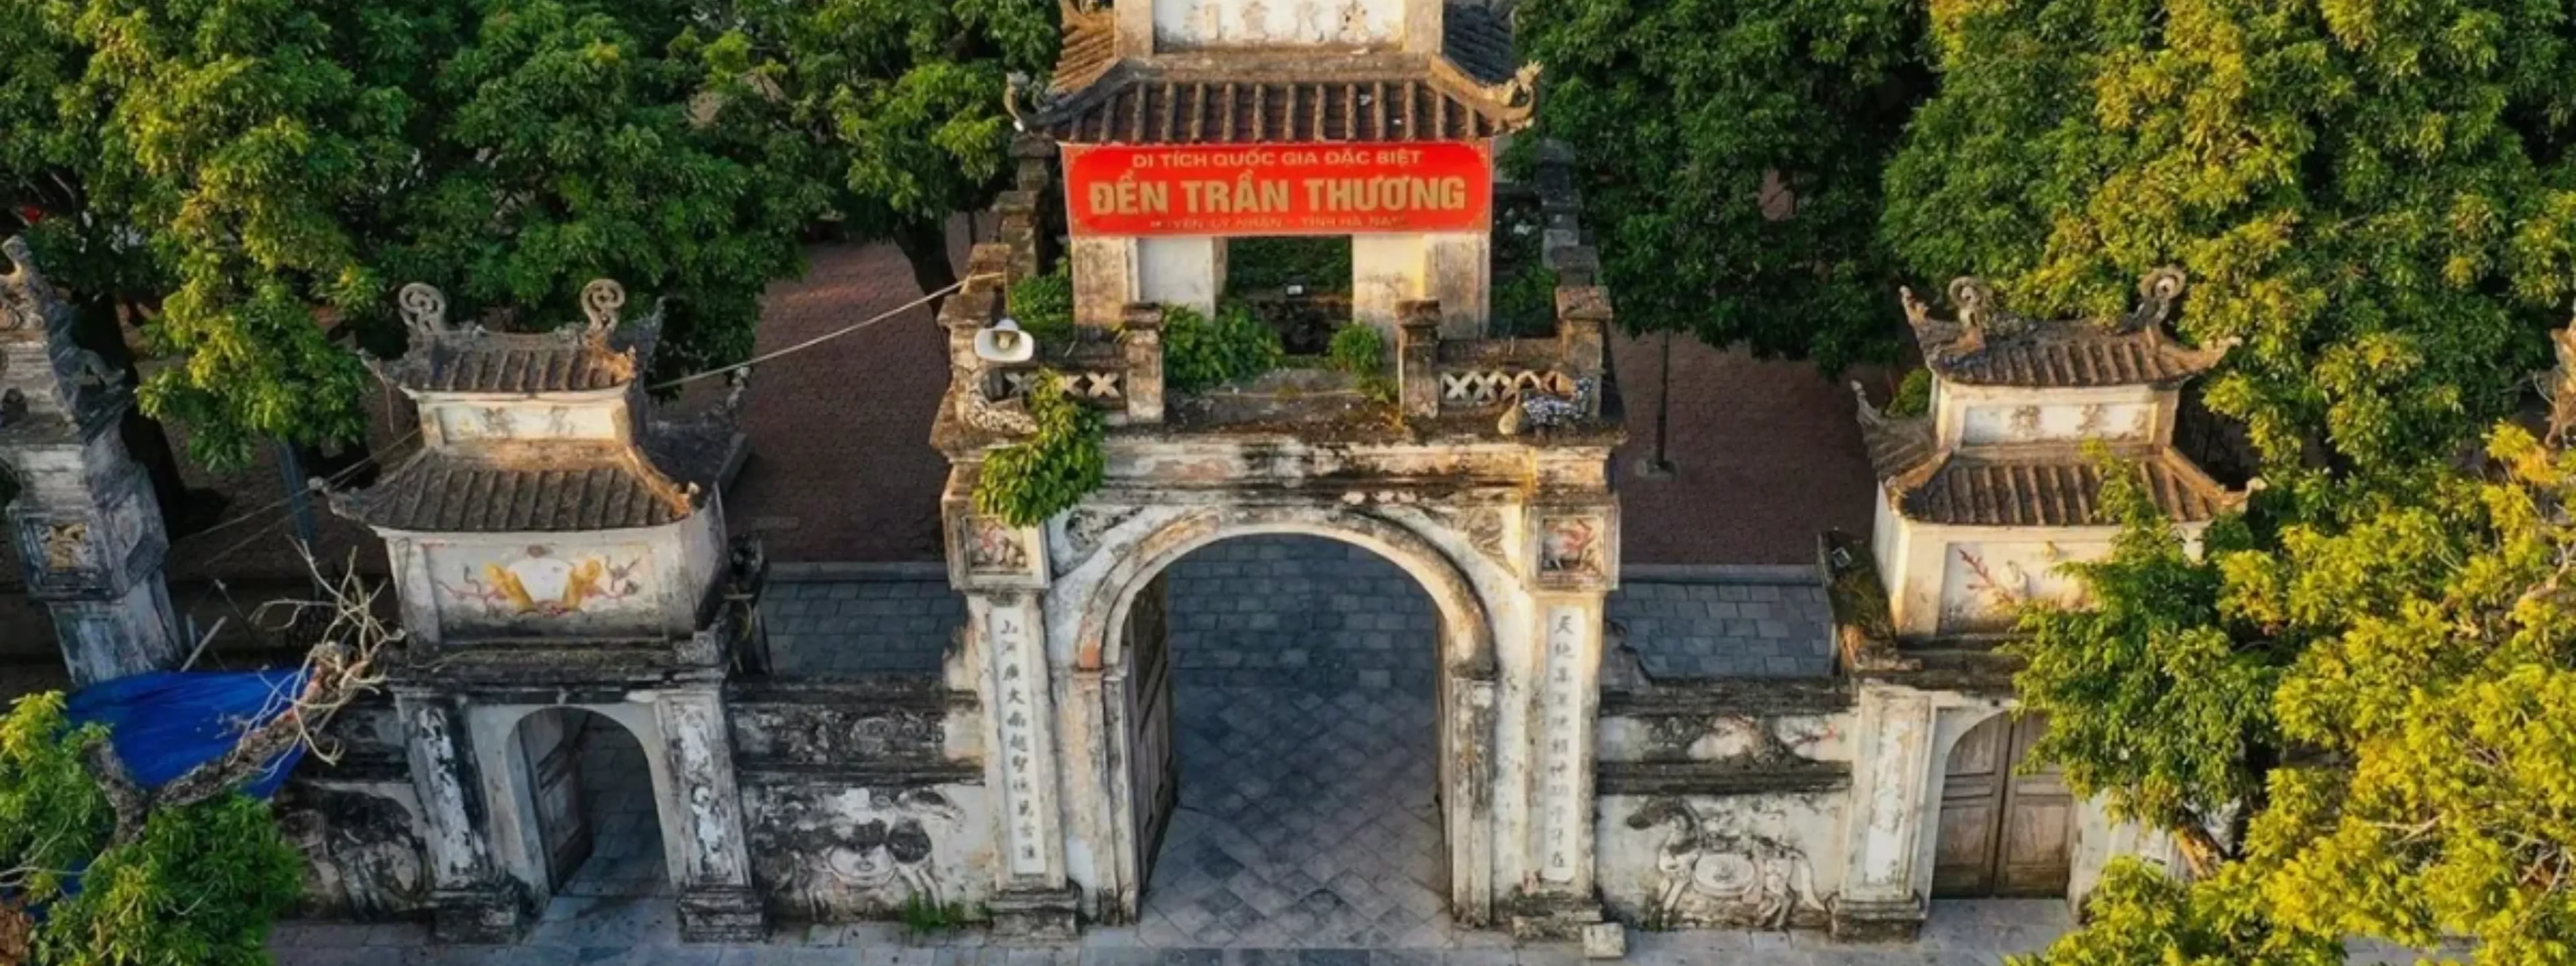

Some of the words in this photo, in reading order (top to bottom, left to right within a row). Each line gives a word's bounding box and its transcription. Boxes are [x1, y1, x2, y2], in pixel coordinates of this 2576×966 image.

[1159, 150, 1207, 168] TÍCH
[1212, 147, 1275, 167] QUỐC
[1281, 151, 1318, 166] GIA
[1324, 148, 1371, 168] ĐẶC
[1376, 147, 1424, 168] BIỆT
[1089, 168, 1169, 215] ĐỀN
[1180, 168, 1289, 213] TRẦN
[1303, 174, 1465, 212] THƯƠNG
